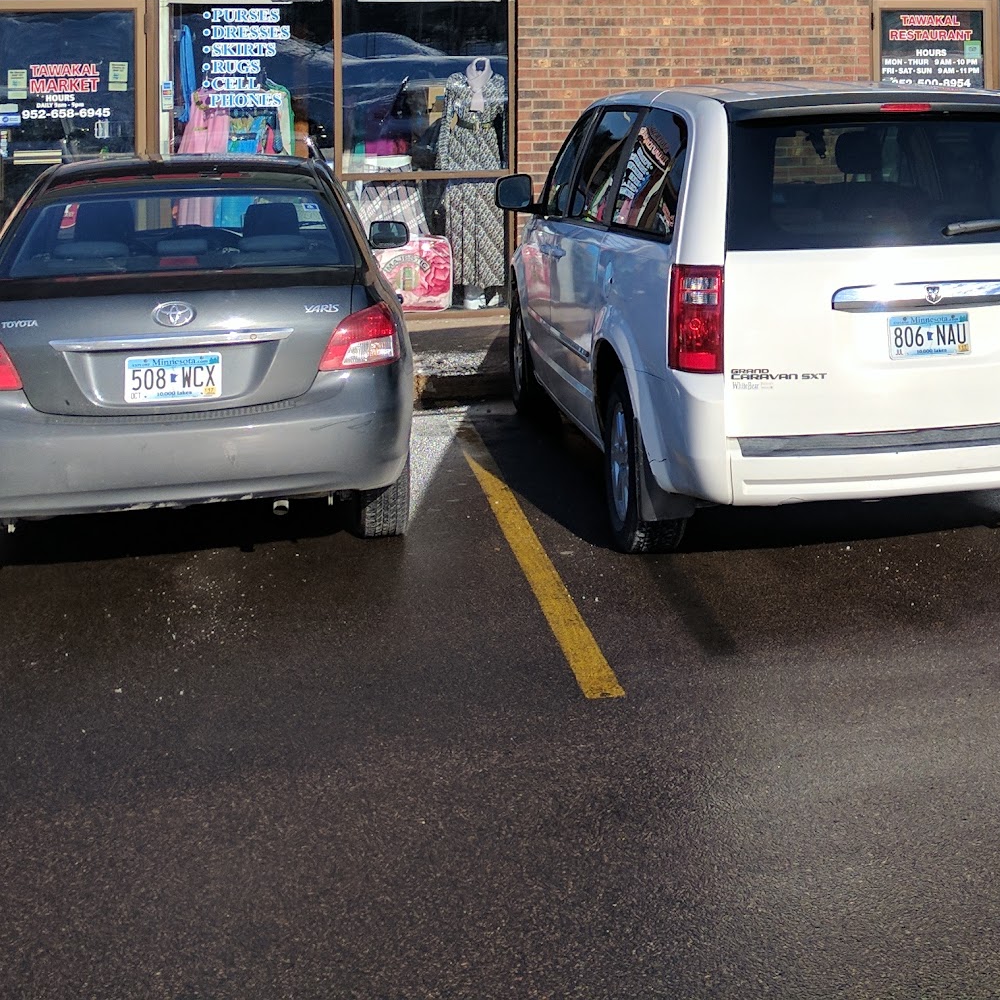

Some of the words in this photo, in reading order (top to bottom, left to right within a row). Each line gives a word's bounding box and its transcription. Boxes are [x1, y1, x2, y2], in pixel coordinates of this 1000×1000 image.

[211, 8, 280, 23] PURSES
[900, 14, 961, 26] TAWAKAL
[211, 25, 290, 39] DRESSES
[889, 29, 973, 41] RESTAURANT
[211, 42, 277, 57] SKIRTS
[916, 49, 947, 57] HOURS
[30, 63, 100, 77] TAWAKAL
[211, 59, 261, 74] RUGS
[30, 78, 100, 94] MARKET
[211, 76, 261, 91] CELL
[45, 94, 75, 102] HOURS
[209, 93, 282, 108] PHONES
[22, 108, 110, 119] 952-658-6945
[304, 303, 340, 313] YARIS
[1, 319, 39, 329] TOYOTA
[894, 326, 925, 348] 806
[936, 323, 967, 346] NAU
[132, 368, 166, 391] 508
[182, 365, 216, 389] WCX
[801, 372, 828, 380] SXT
